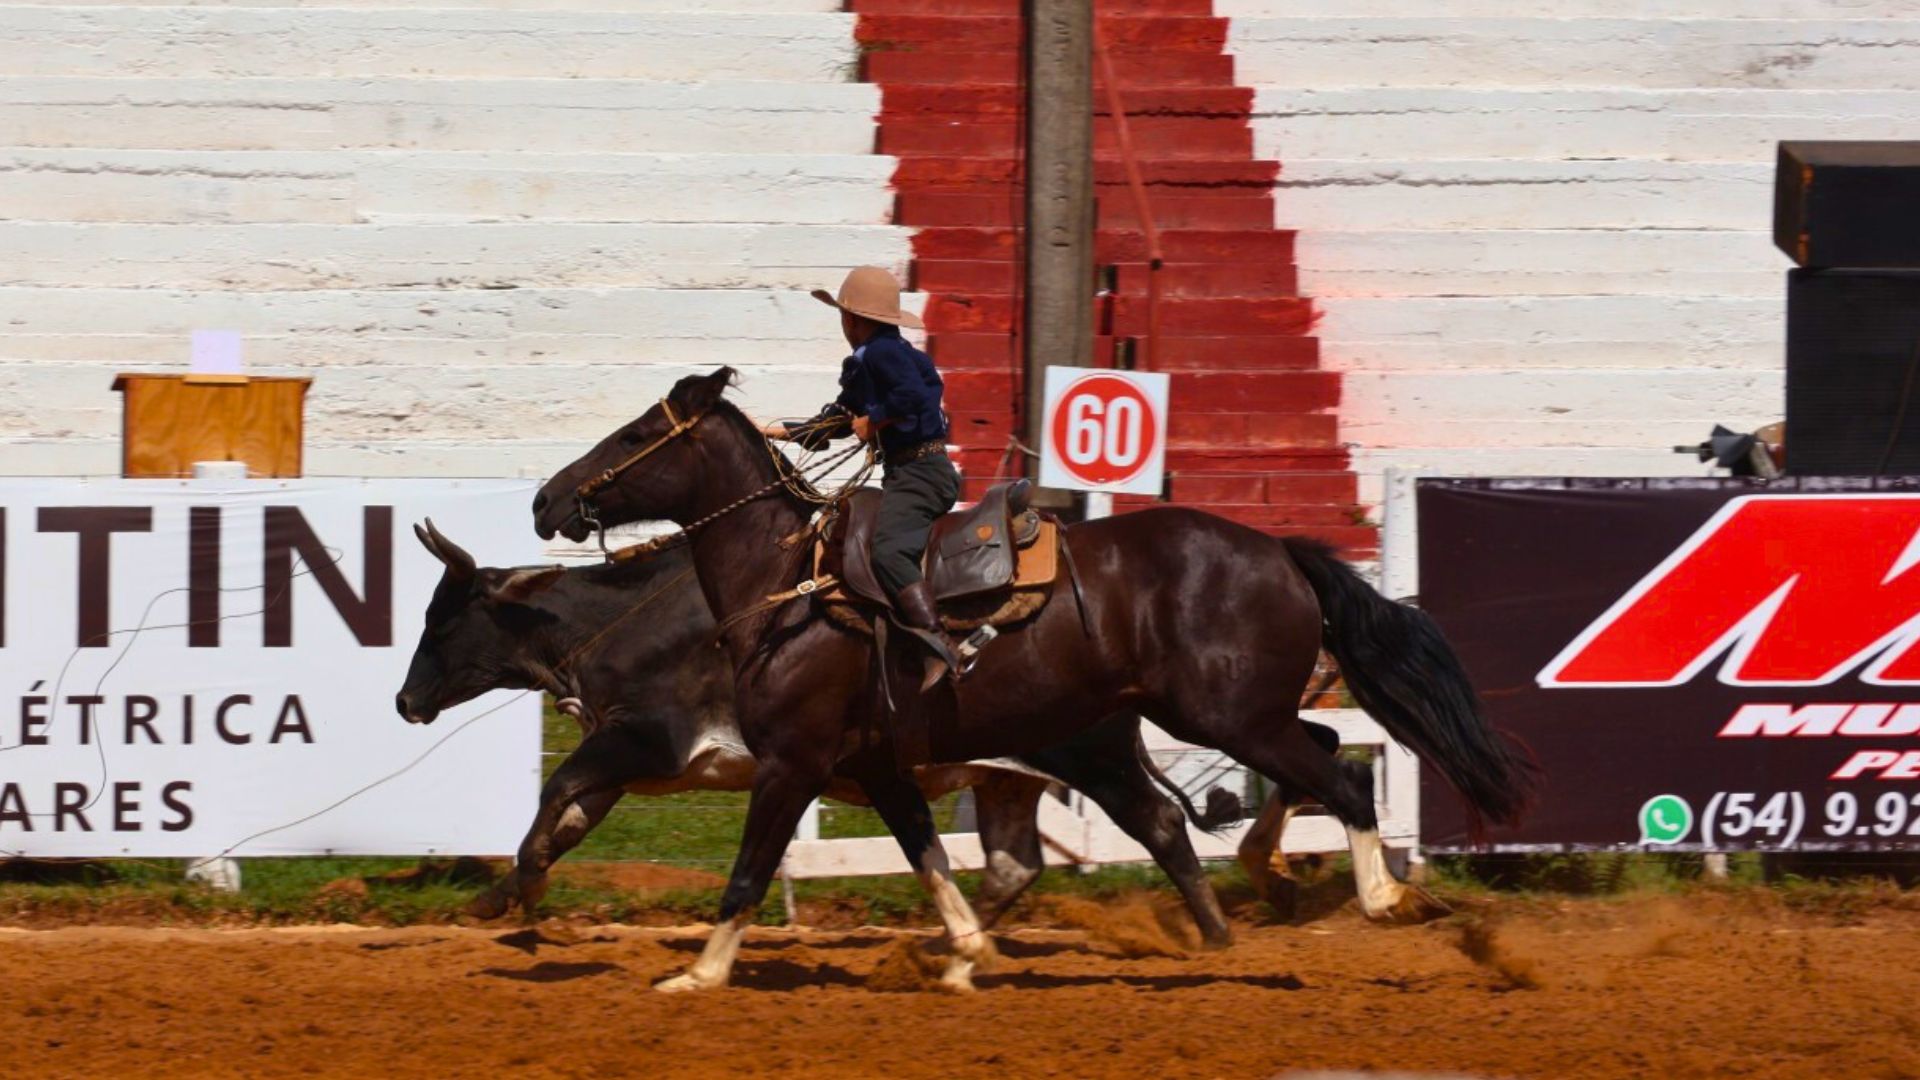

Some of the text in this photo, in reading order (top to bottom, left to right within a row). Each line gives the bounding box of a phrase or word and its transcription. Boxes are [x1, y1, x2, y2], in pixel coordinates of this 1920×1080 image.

[1065, 393, 1142, 467] 60
[0, 505, 394, 648] TIN
[0, 782, 194, 832] ARES
[1701, 791, 1805, 850] (54)
